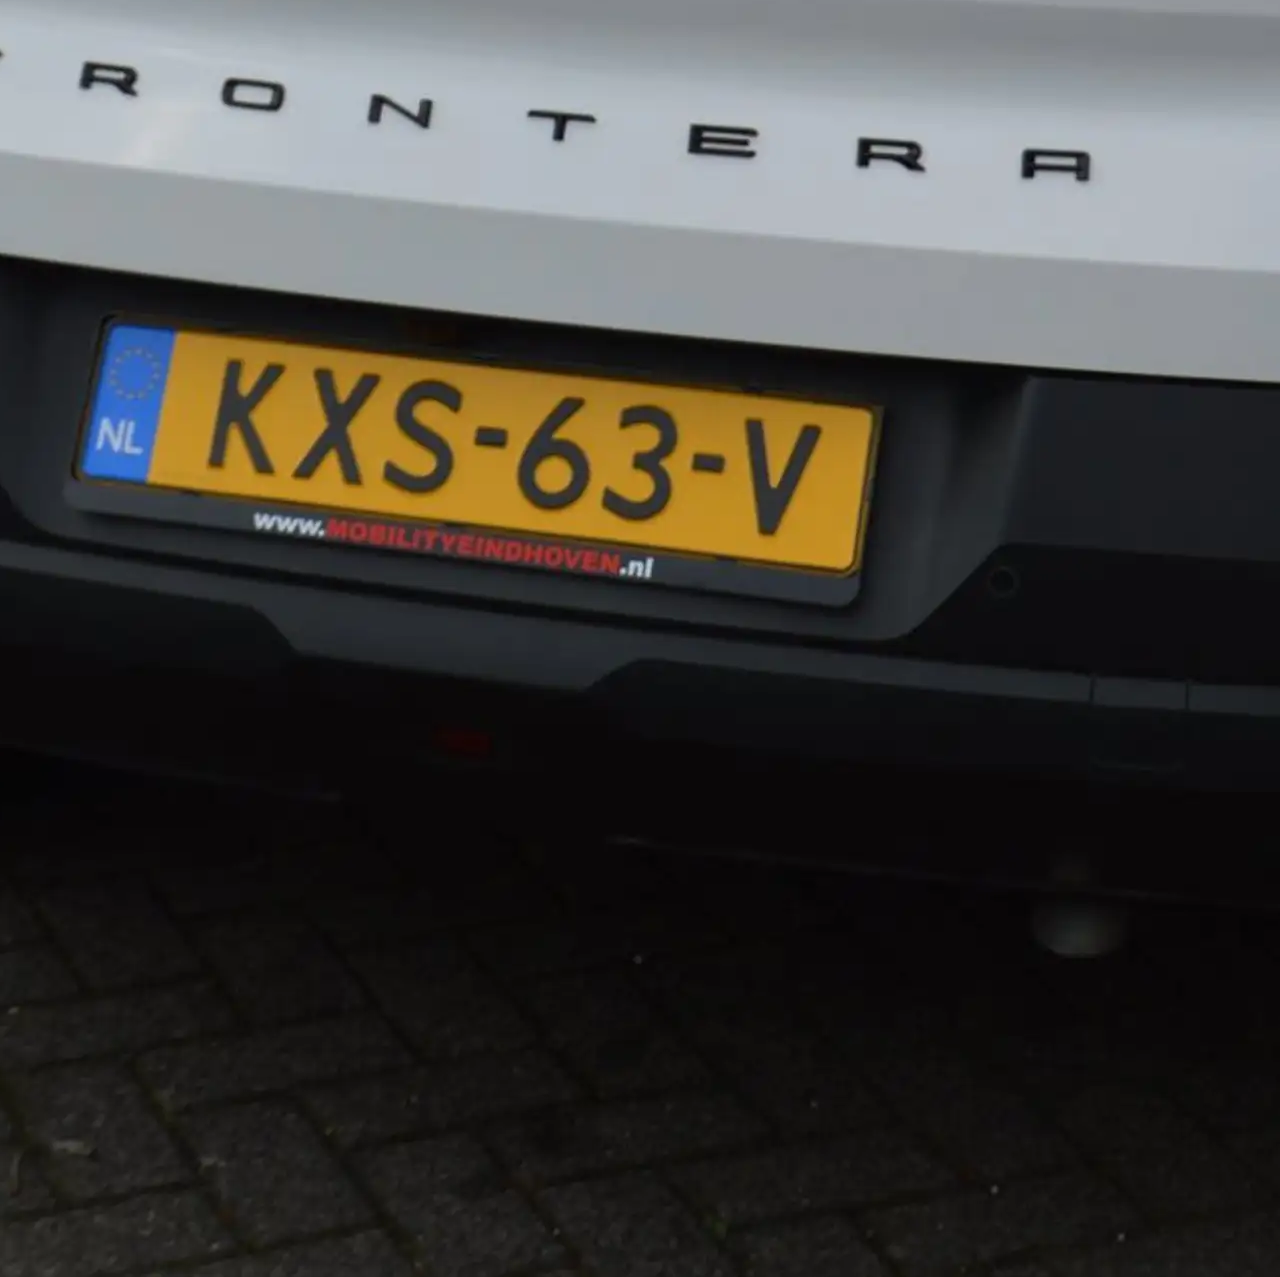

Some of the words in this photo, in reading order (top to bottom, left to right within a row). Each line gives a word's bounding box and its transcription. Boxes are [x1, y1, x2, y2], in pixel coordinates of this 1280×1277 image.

[95, 416, 144, 456] NL
[207, 358, 823, 537] KXS-63-V
[252, 511, 654, 580] www.MOBILITYEINDHOVEN.nl
